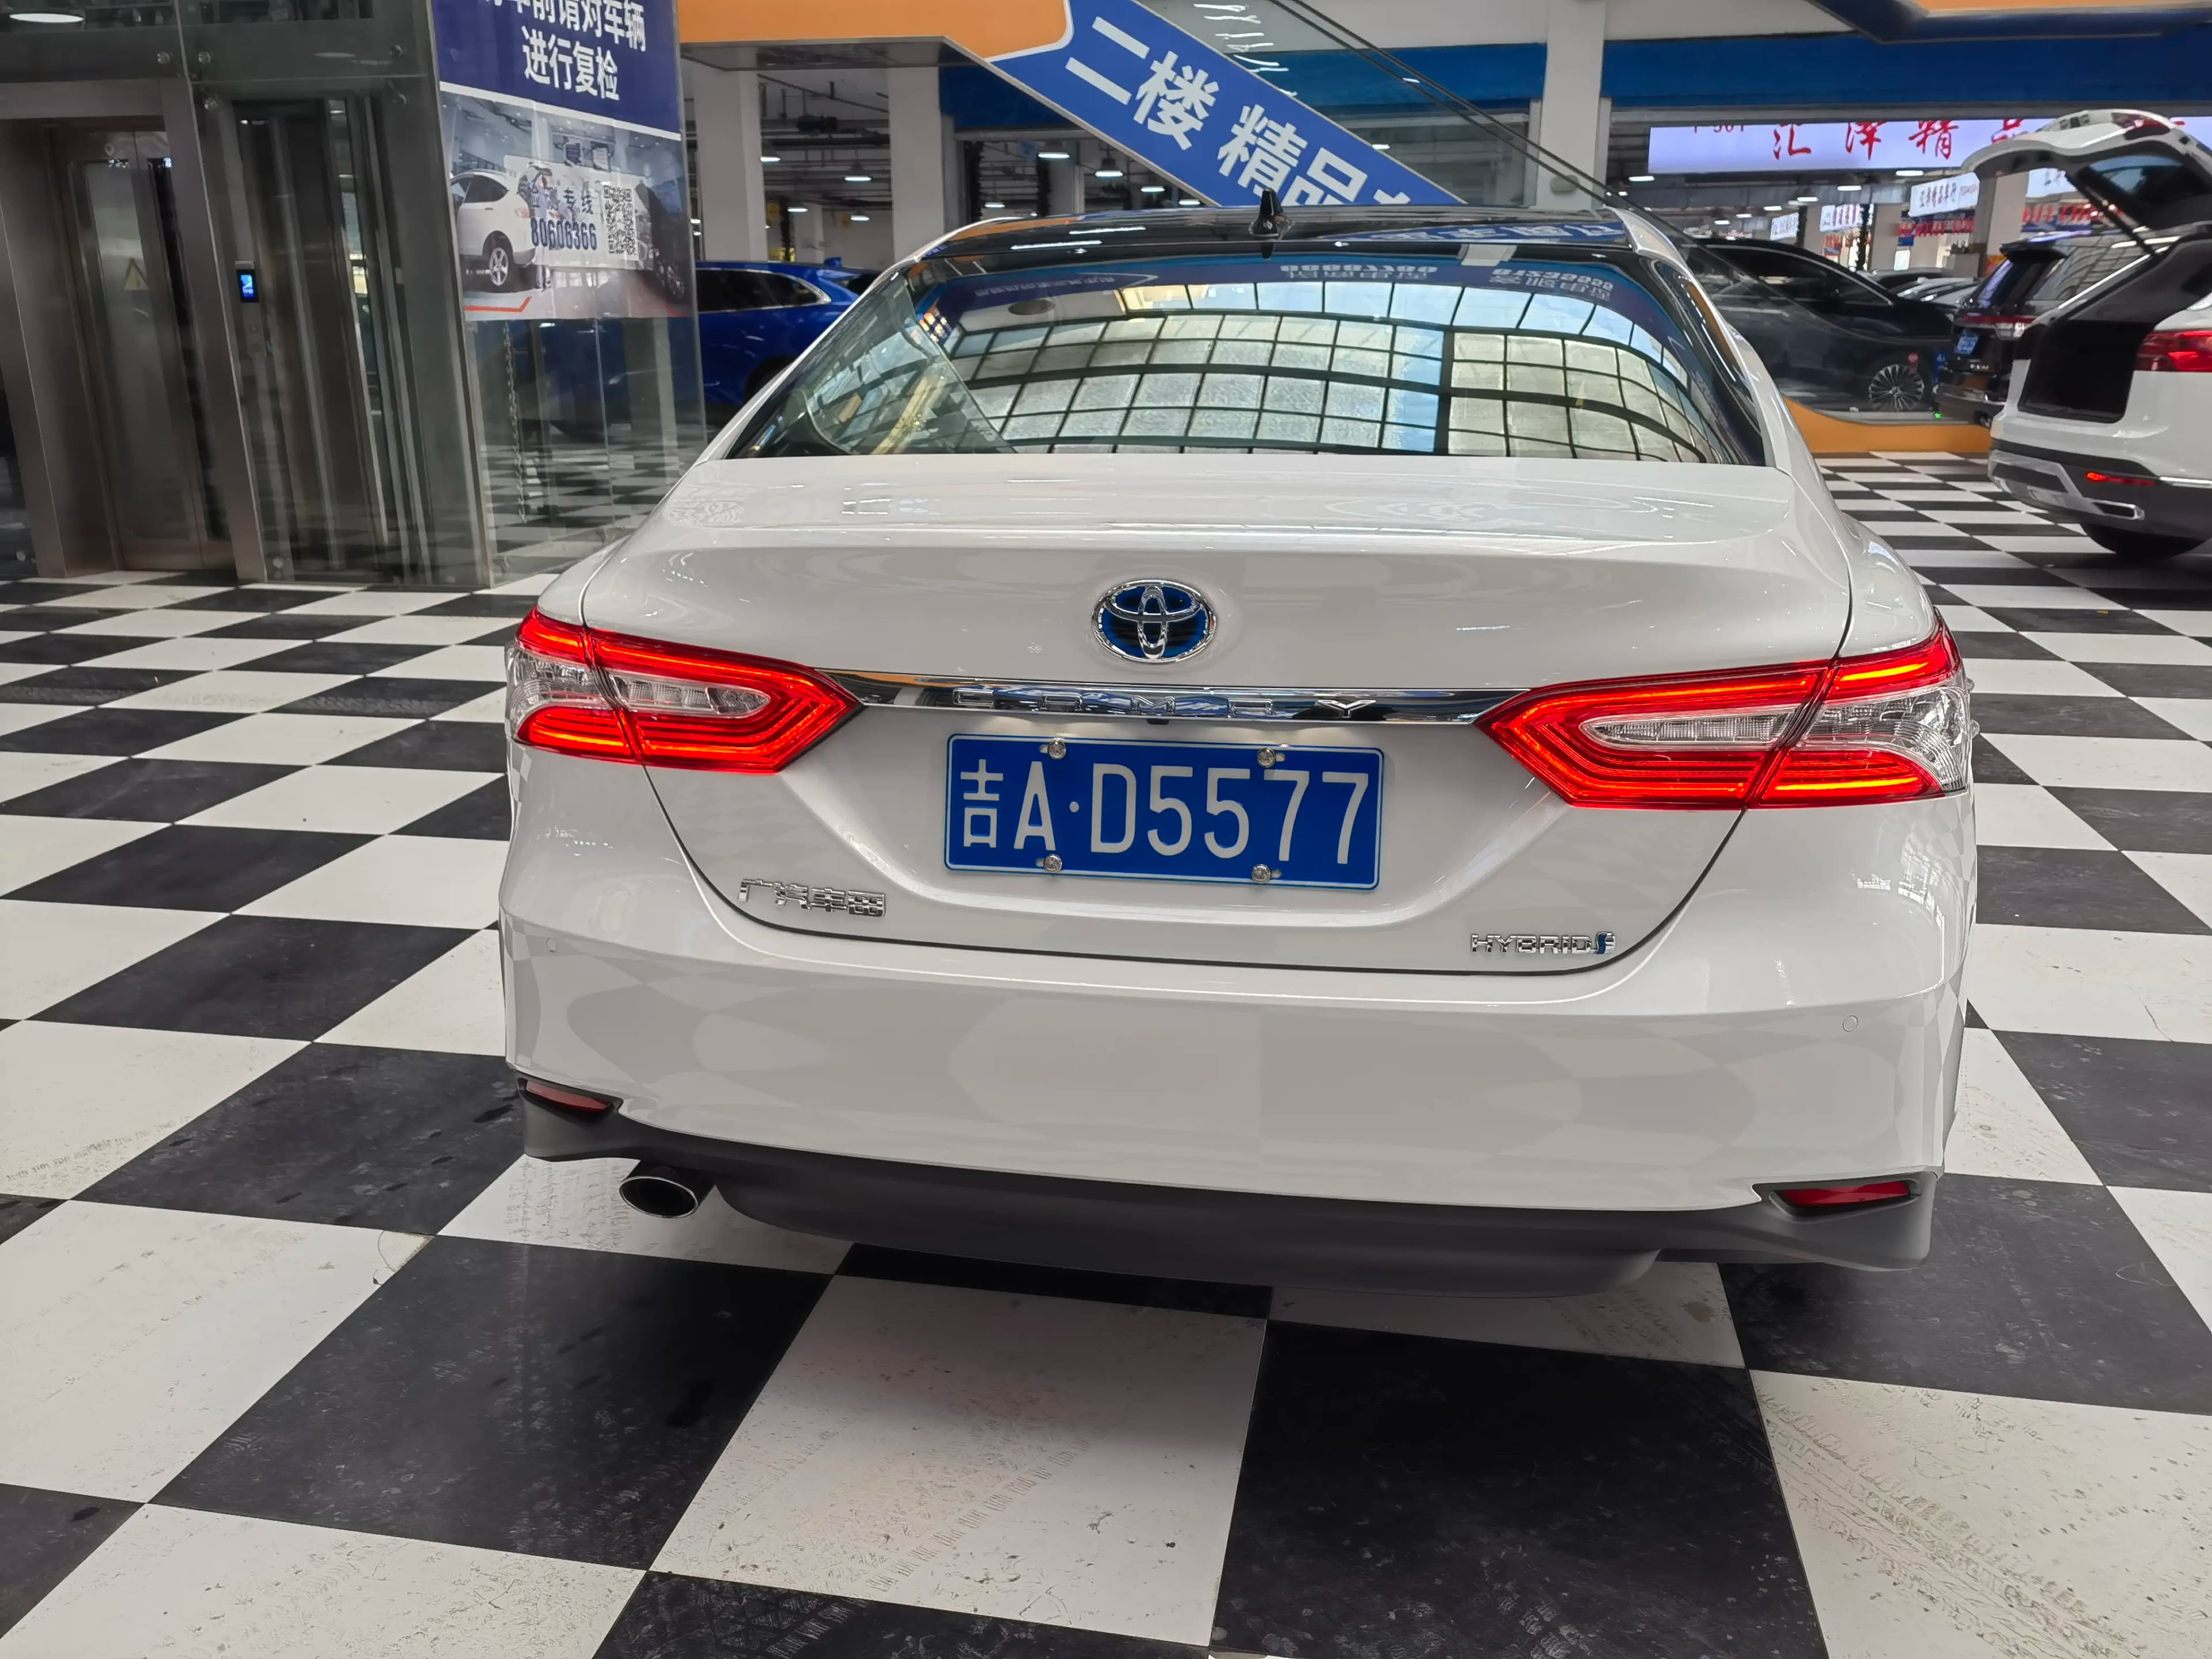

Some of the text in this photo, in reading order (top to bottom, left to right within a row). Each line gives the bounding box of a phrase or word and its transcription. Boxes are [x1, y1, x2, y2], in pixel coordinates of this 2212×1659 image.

[521, 25, 620, 100] 进行复检
[1065, 16, 1411, 206] 二楼 精品
[953, 689, 1377, 719] CAMRY
[960, 759, 1369, 865] 吉A·D5577
[738, 878, 885, 916] 广汽丰田
[1471, 934, 1592, 954] HYBRID
